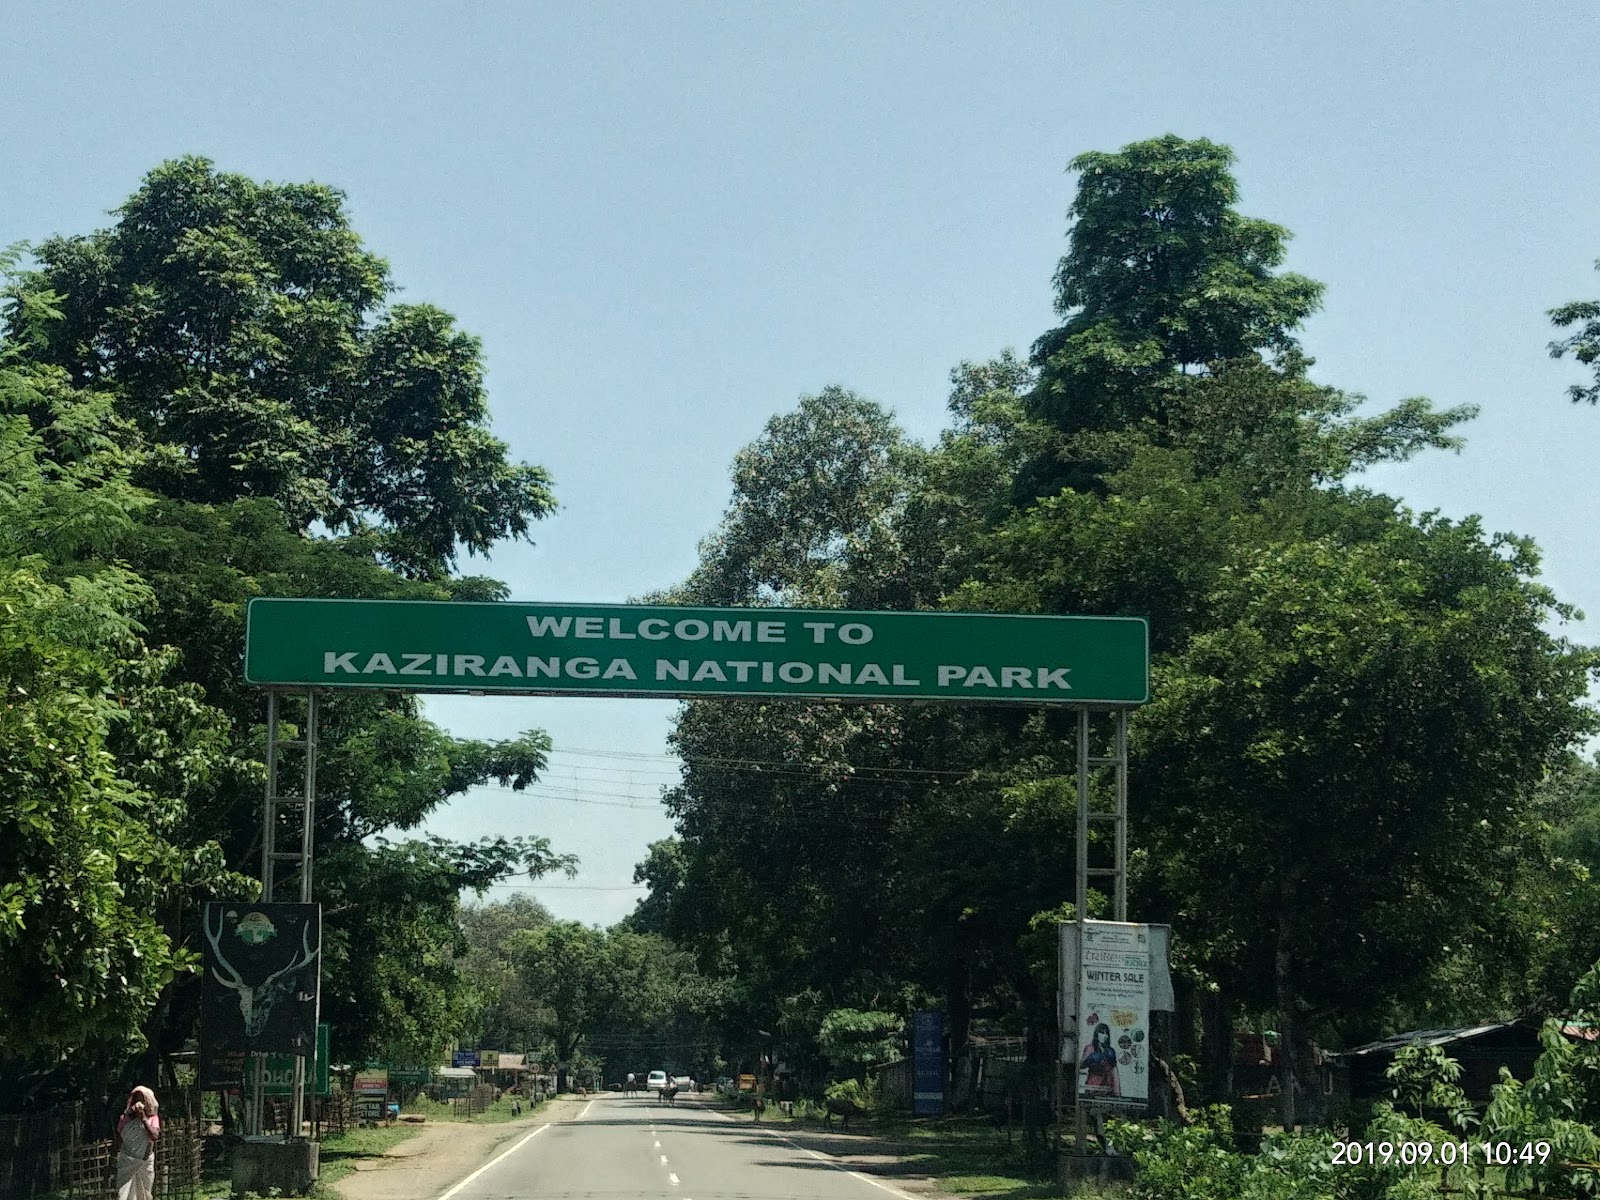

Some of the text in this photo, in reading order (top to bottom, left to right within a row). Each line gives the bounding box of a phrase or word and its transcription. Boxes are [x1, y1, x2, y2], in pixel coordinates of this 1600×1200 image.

[526, 615, 875, 646] WELCOME TO
[323, 651, 1073, 690] KAZIRANGA NATIONAL PARK
[1086, 970, 1145, 983] WINTER SALE
